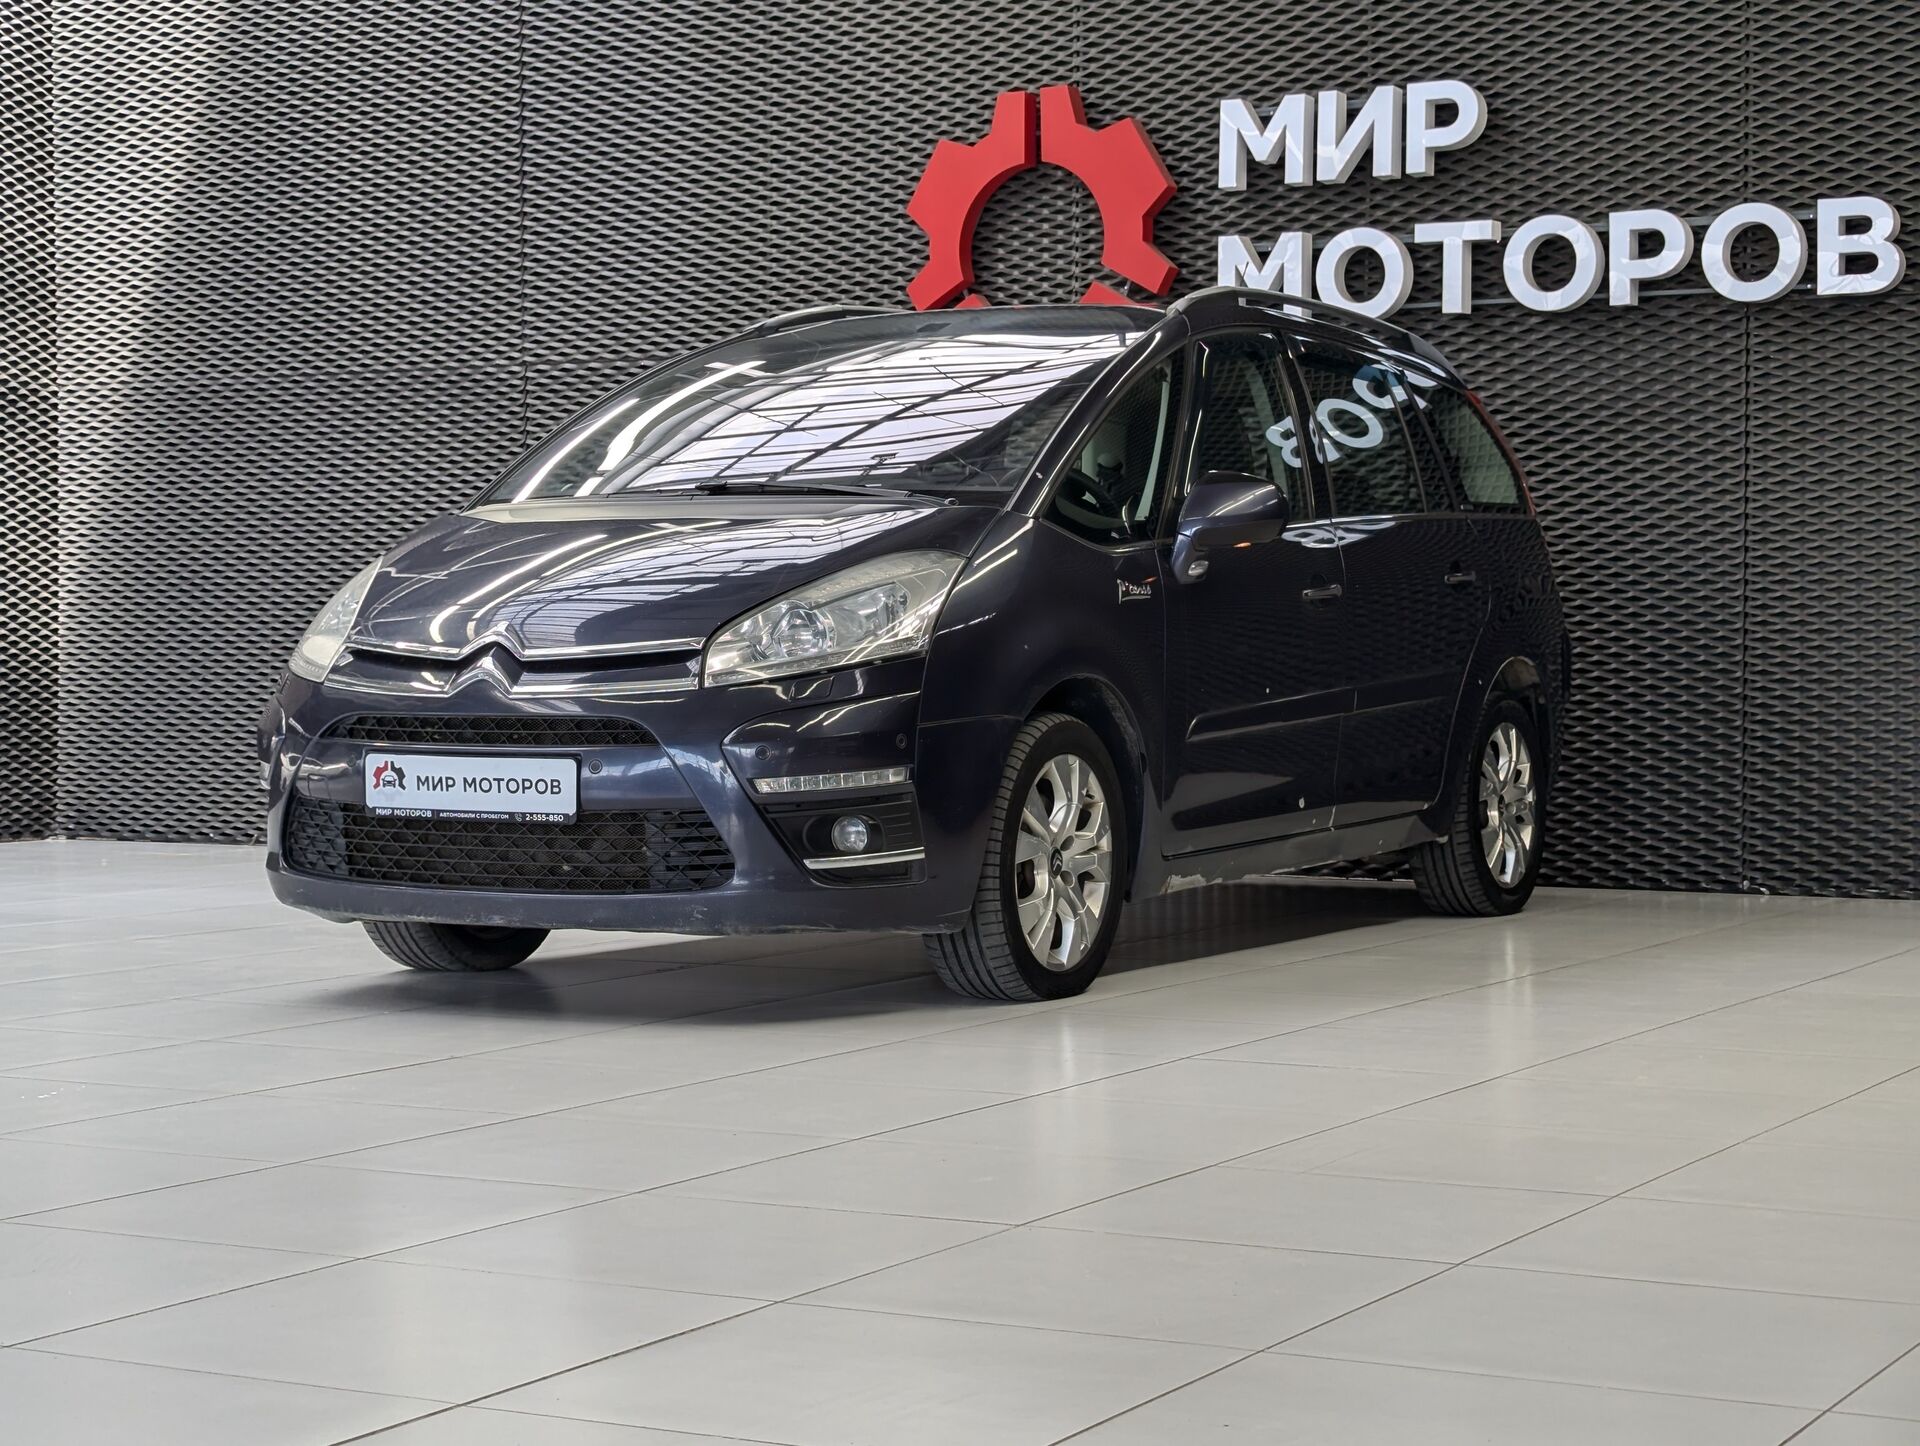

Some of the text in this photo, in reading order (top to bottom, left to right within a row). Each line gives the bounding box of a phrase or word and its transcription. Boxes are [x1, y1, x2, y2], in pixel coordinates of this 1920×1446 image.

[1218, 79, 1487, 191] МИР
[1217, 195, 1905, 319] МОТОРОВ
[416, 775, 562, 795] МИР МОТОРОВ
[375, 807, 432, 818] МИР МОТОРОВ
[525, 813, 564, 822] 2-555-850
